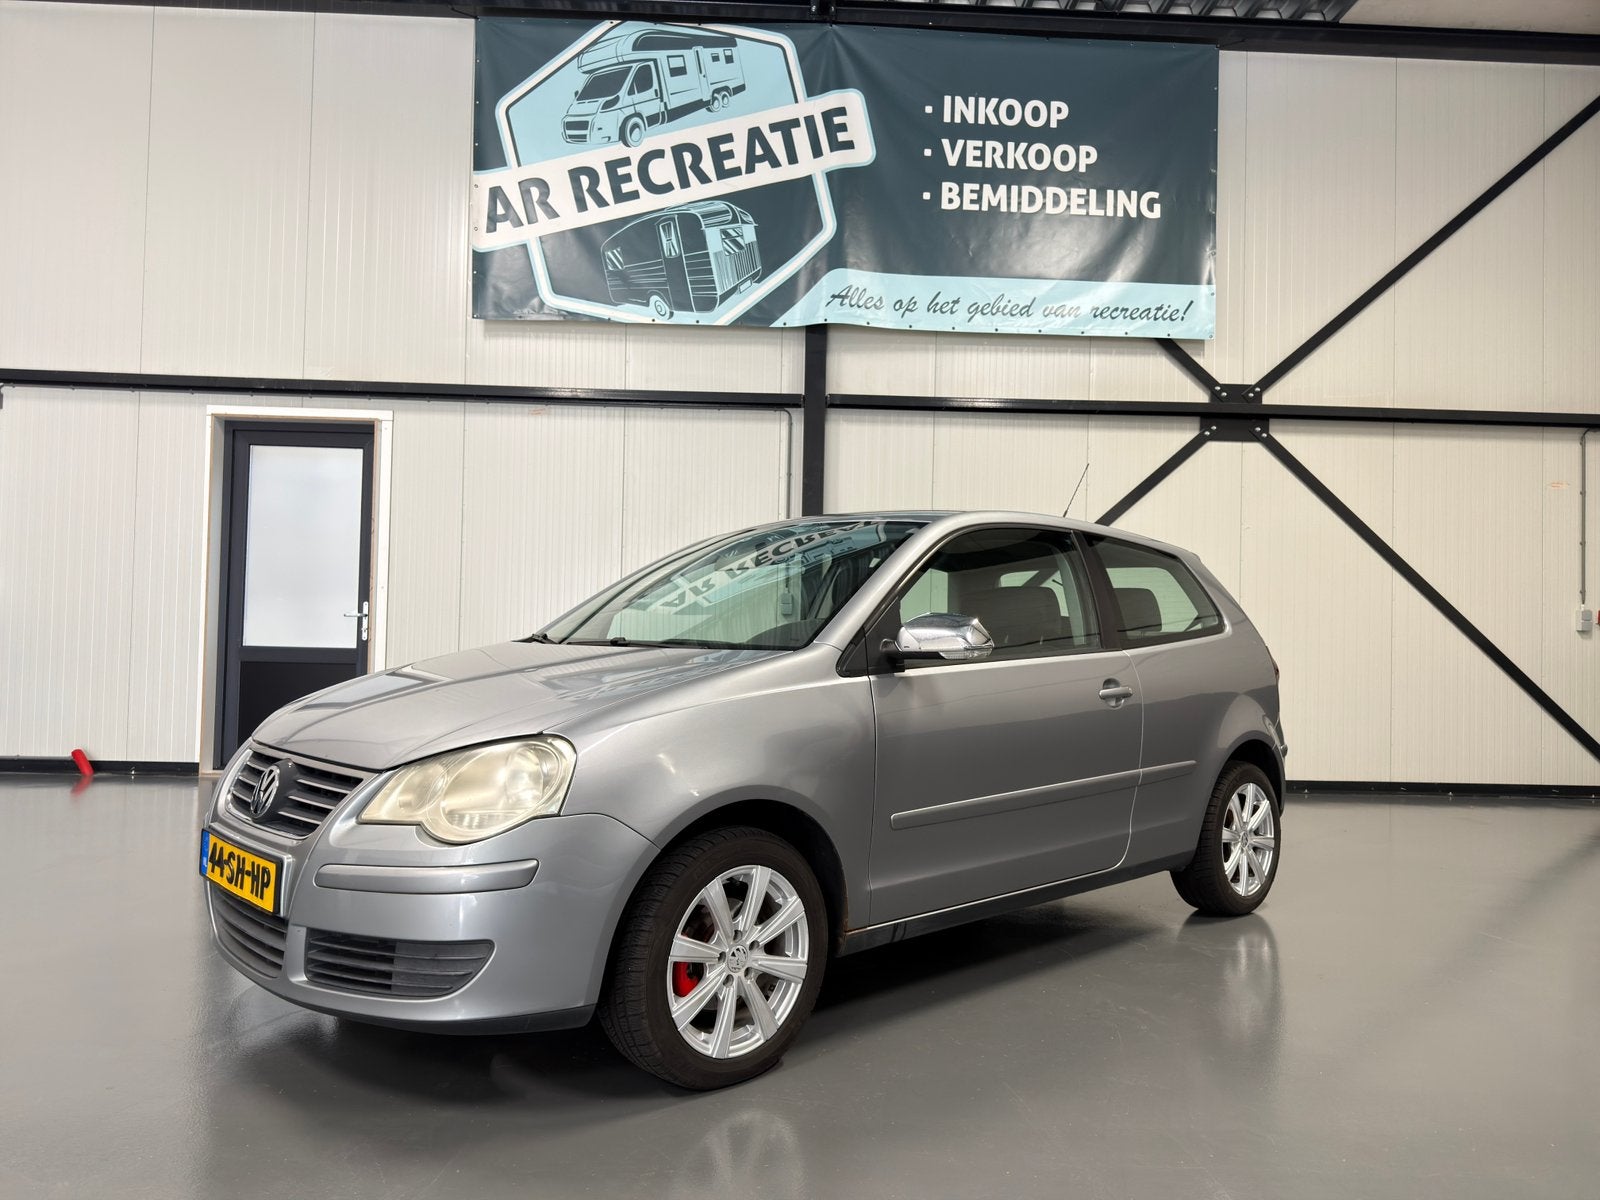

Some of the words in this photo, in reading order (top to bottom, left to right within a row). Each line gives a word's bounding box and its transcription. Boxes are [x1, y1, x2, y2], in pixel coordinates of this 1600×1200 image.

[942, 95, 1069, 128] INKOOP
[485, 177, 560, 234] AR
[567, 106, 855, 213] RECREATIE
[941, 138, 1098, 173] VERKOOP
[940, 181, 1161, 219] BEMIDDELING
[826, 284, 885, 311] Alles
[893, 294, 918, 313] op
[927, 292, 960, 314] het
[967, 294, 1036, 322] gebied
[1042, 301, 1081, 318] van
[1089, 300, 1194, 323] recreatie!
[208, 842, 271, 900] 44-SH-HP
